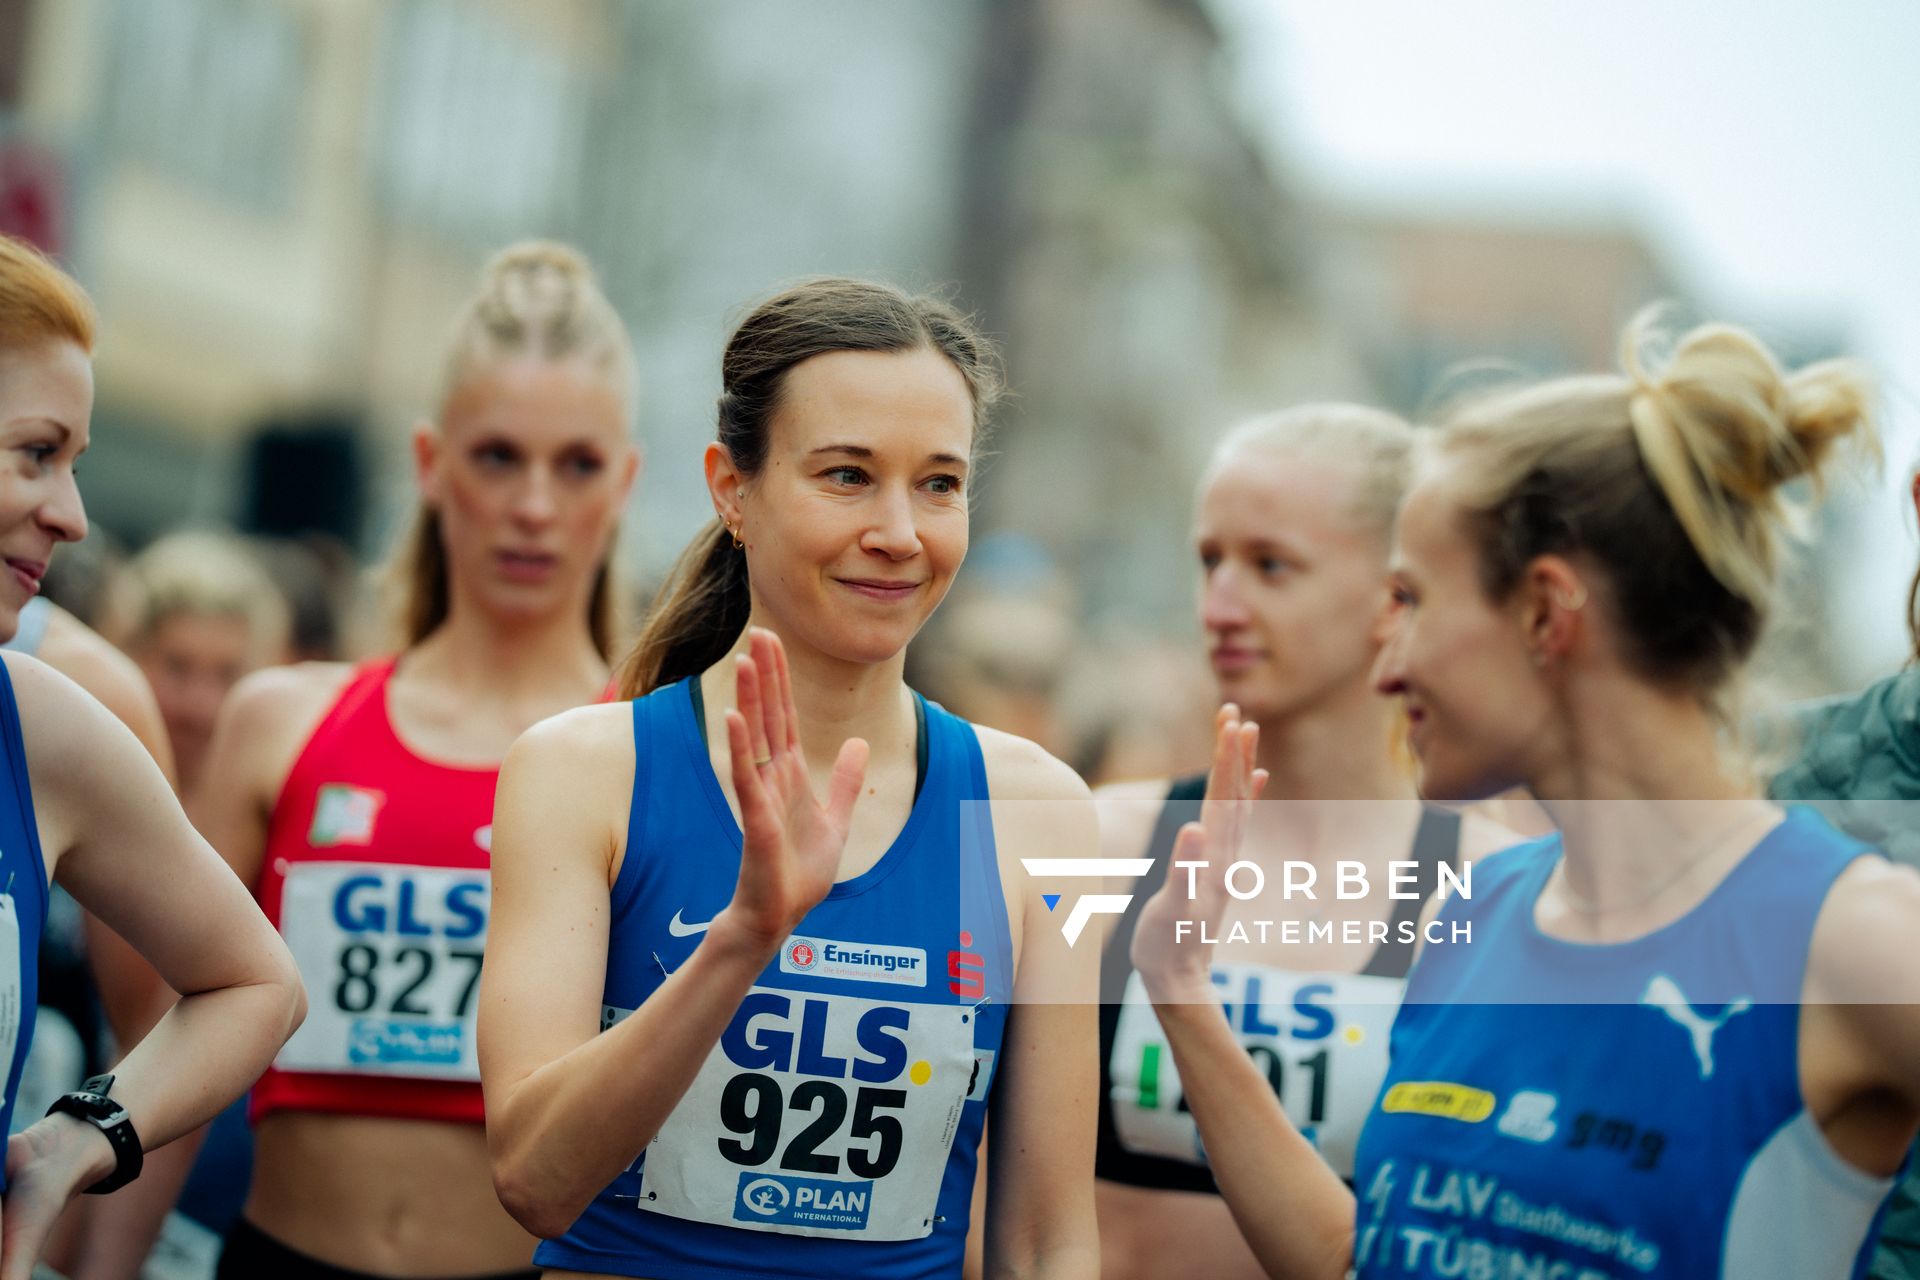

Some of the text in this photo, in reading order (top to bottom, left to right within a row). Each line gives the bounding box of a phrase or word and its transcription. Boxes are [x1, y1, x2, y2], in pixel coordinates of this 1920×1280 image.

[333, 875, 485, 939] GLS
[334, 944, 485, 1018] 827
[823, 944, 920, 971] Ensinger
[717, 1072, 908, 1179] 925
[794, 1211, 862, 1223] INTERNATIONAL
[795, 1187, 866, 1212] PLAN
[1410, 1164, 1497, 1217] LAV
